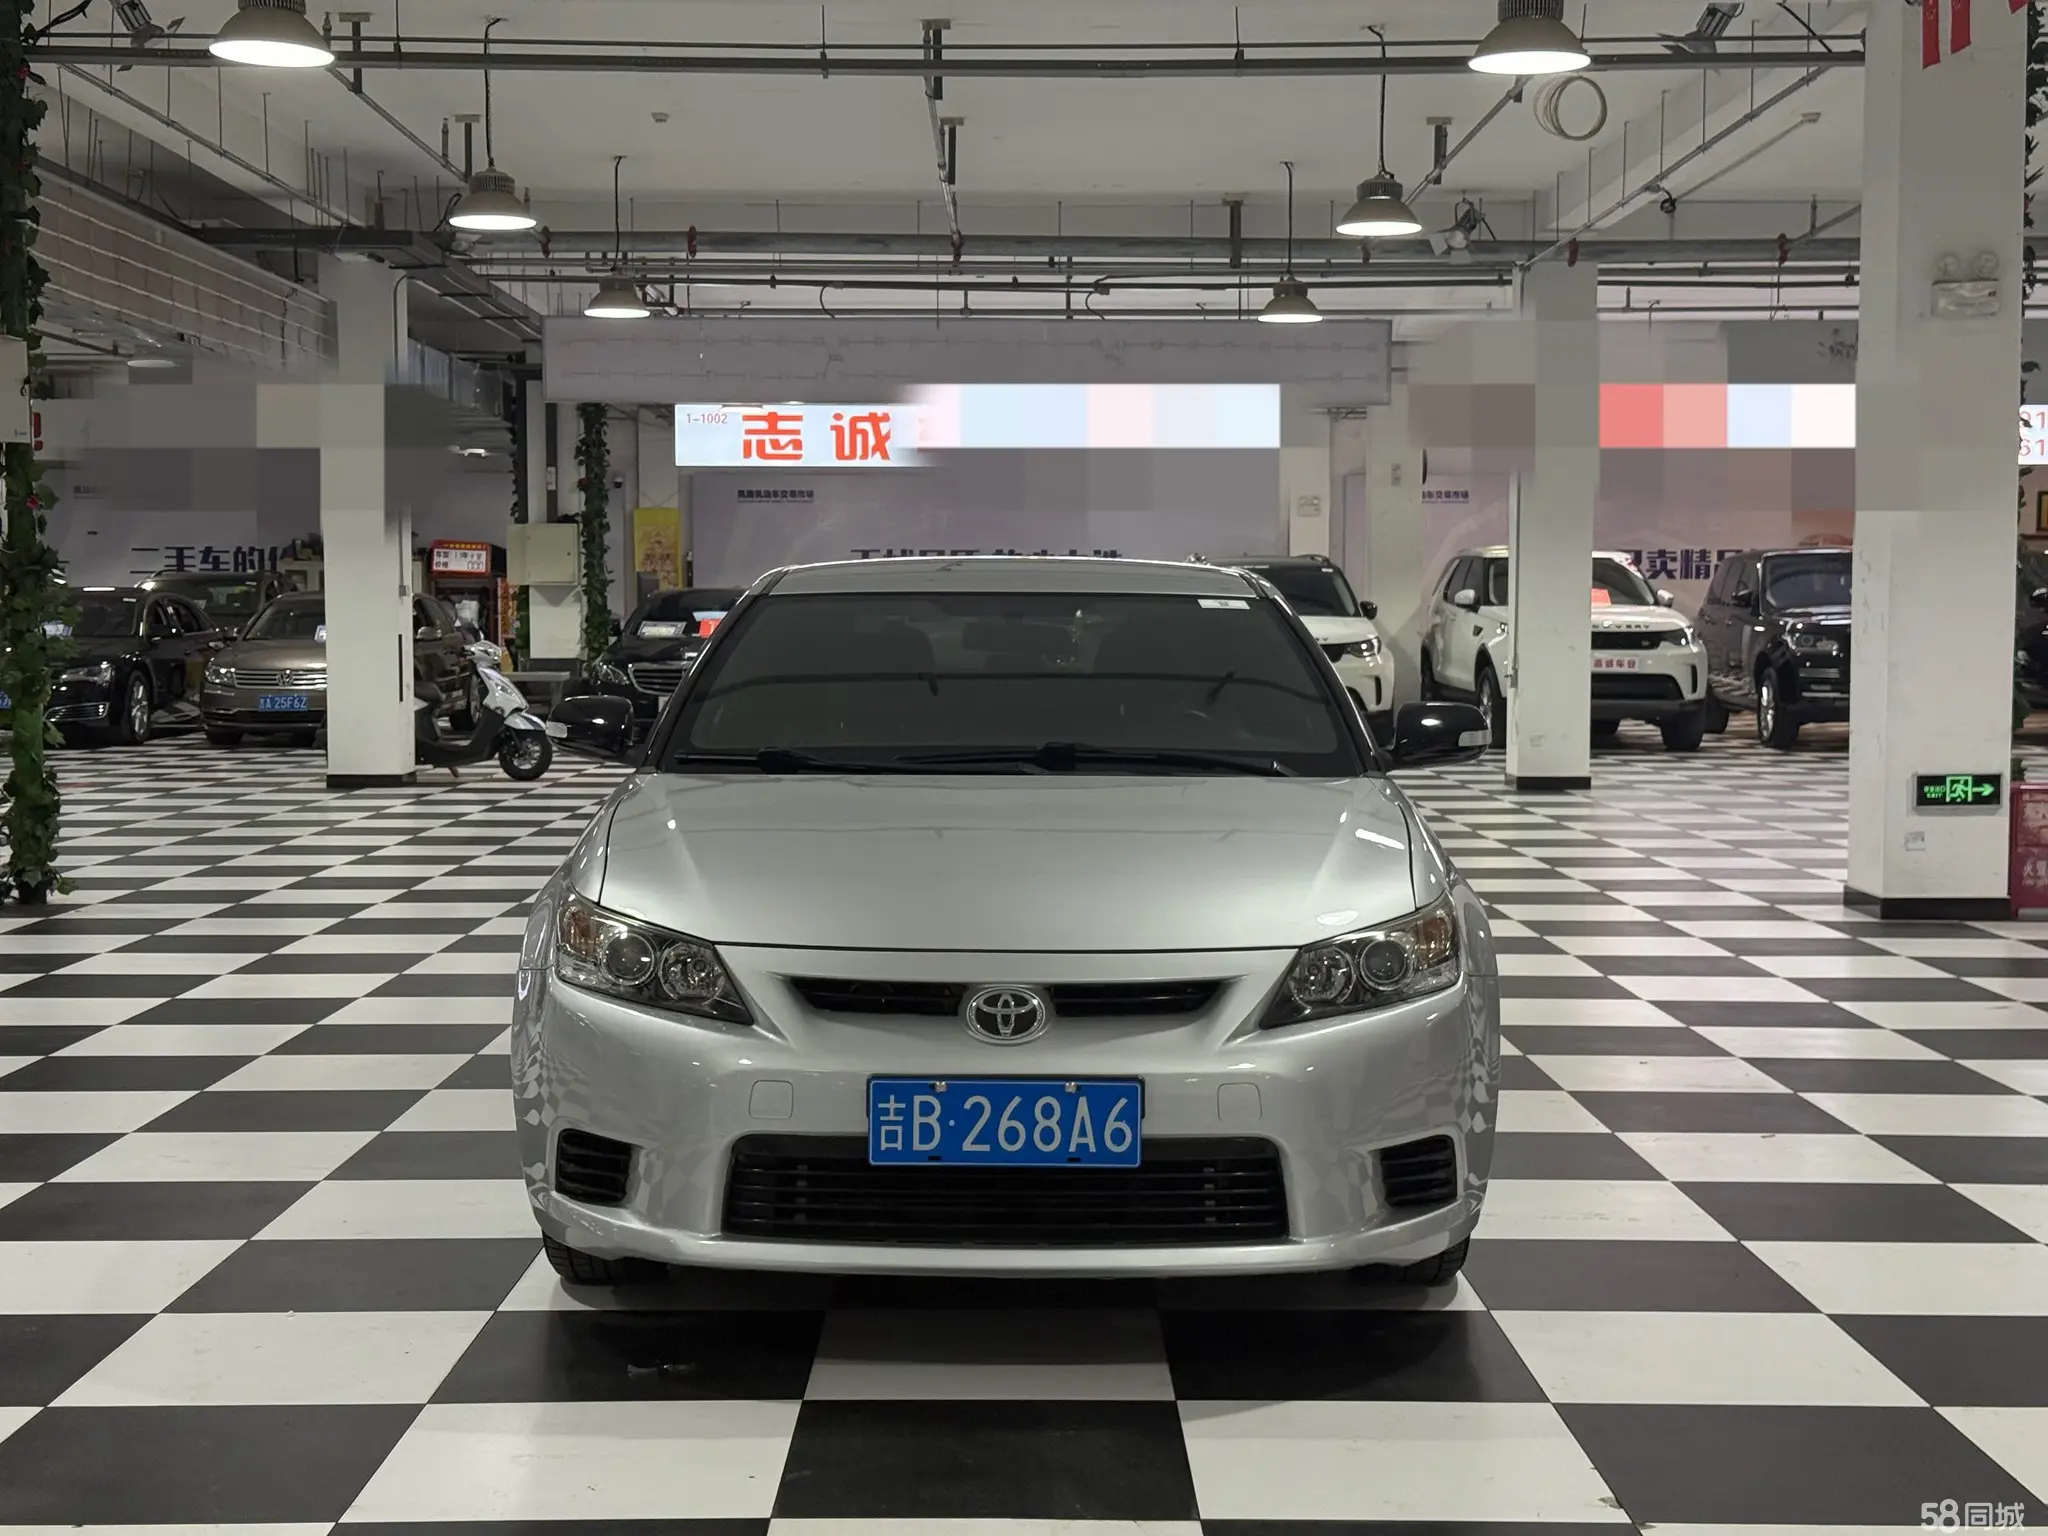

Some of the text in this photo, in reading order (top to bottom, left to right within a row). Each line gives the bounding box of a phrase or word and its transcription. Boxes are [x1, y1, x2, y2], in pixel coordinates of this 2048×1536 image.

[686, 413, 728, 425] 1-1002
[741, 411, 892, 461] 志诚
[877, 1094, 1133, 1153] 吉B·268A6
